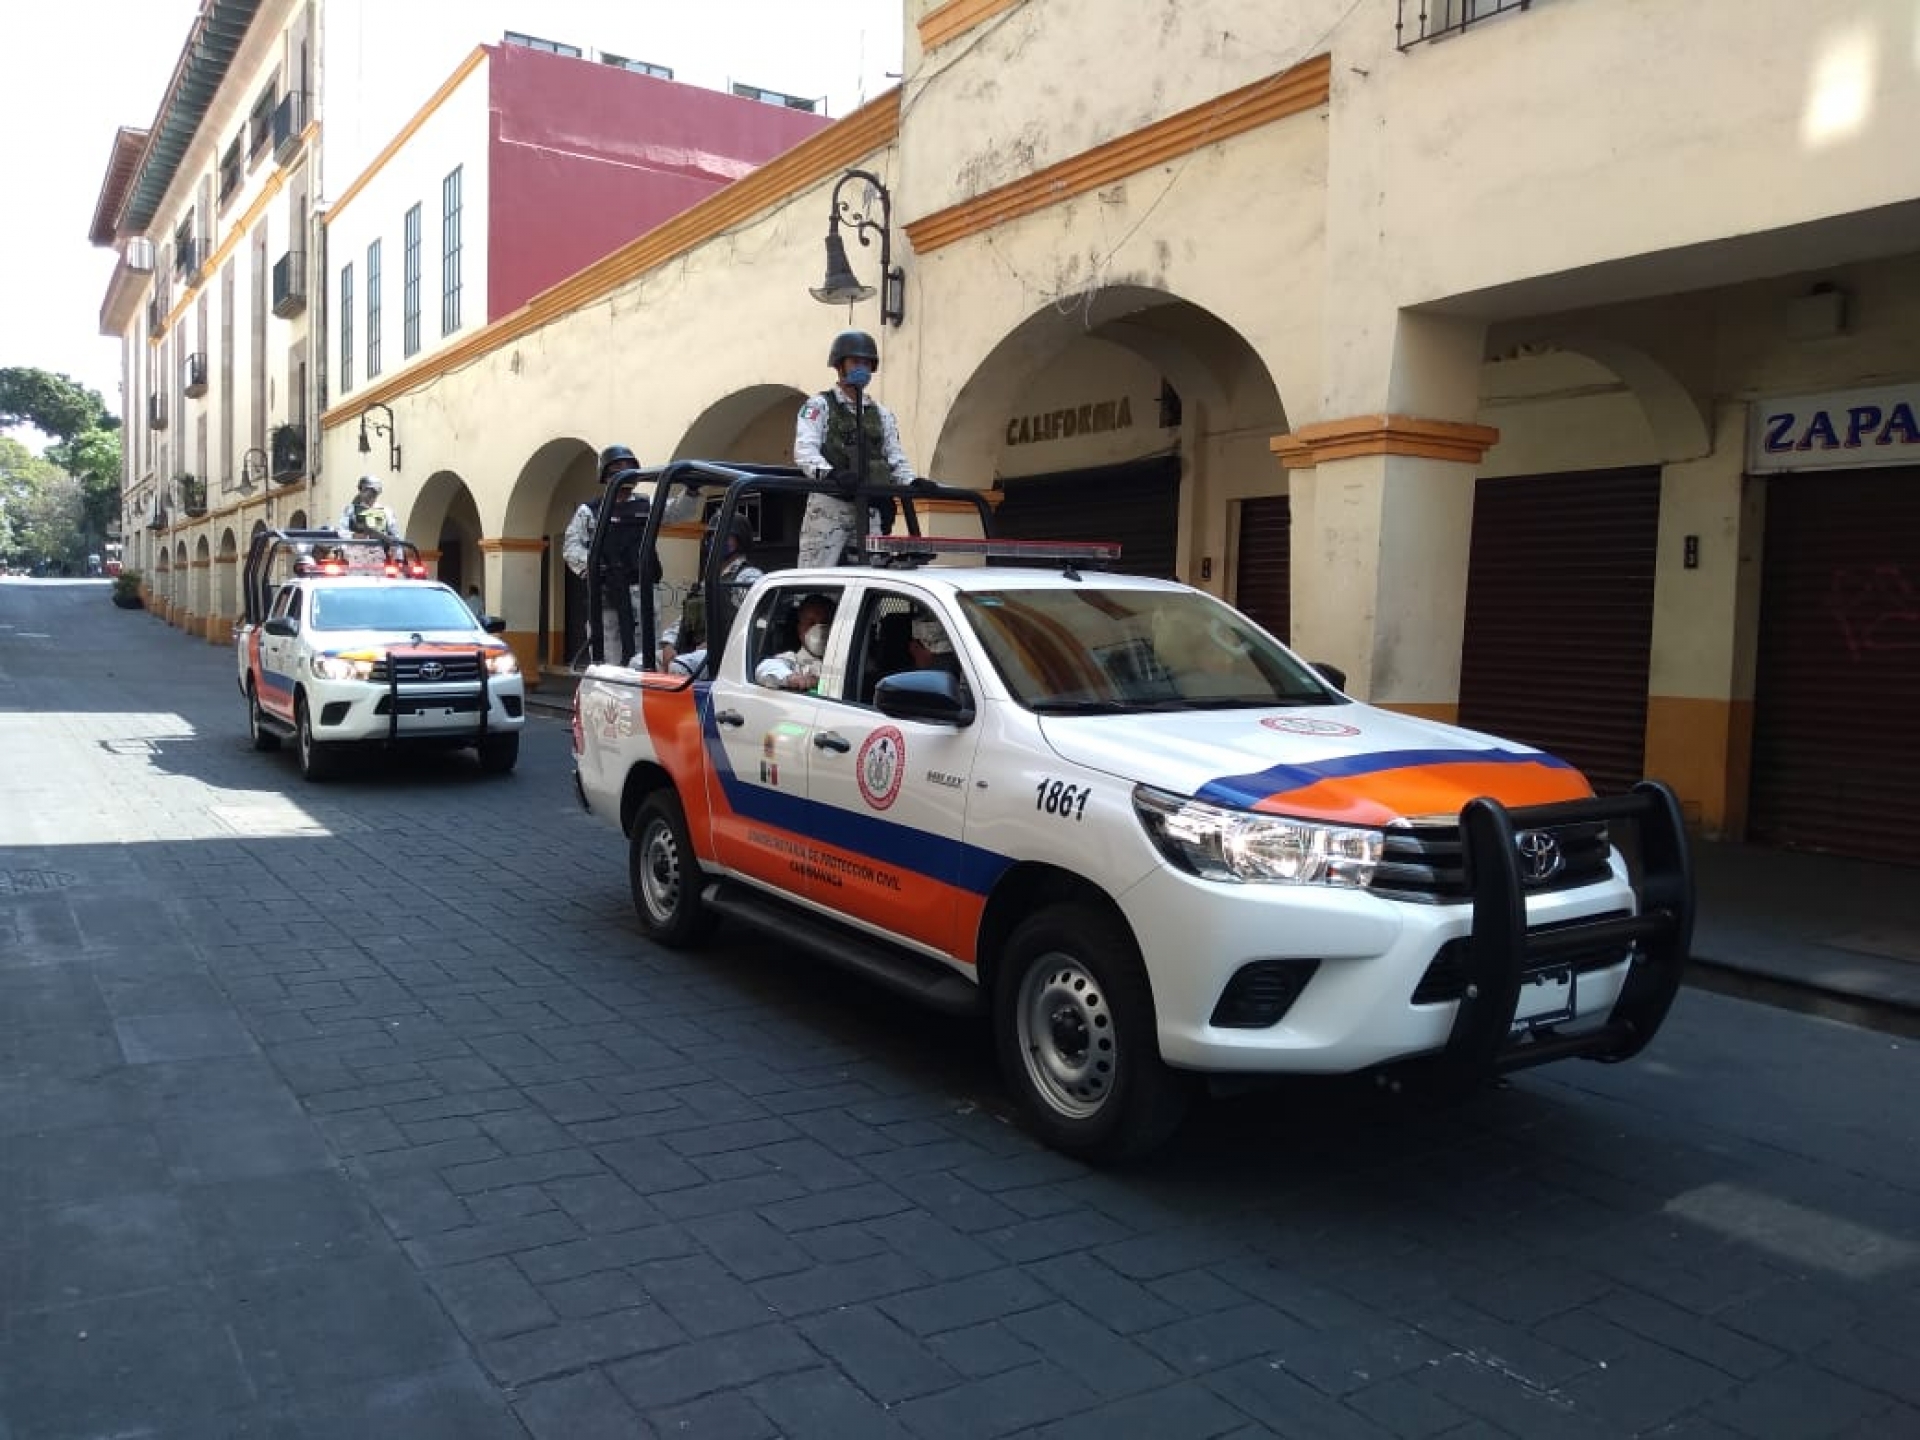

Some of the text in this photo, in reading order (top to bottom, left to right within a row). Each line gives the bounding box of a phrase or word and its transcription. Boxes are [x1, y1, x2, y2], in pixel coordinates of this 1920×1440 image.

[1006, 396, 1133, 446] CALIFORNIA
[1036, 777, 1092, 821] 1861
[876, 870, 902, 891] CIVIL
